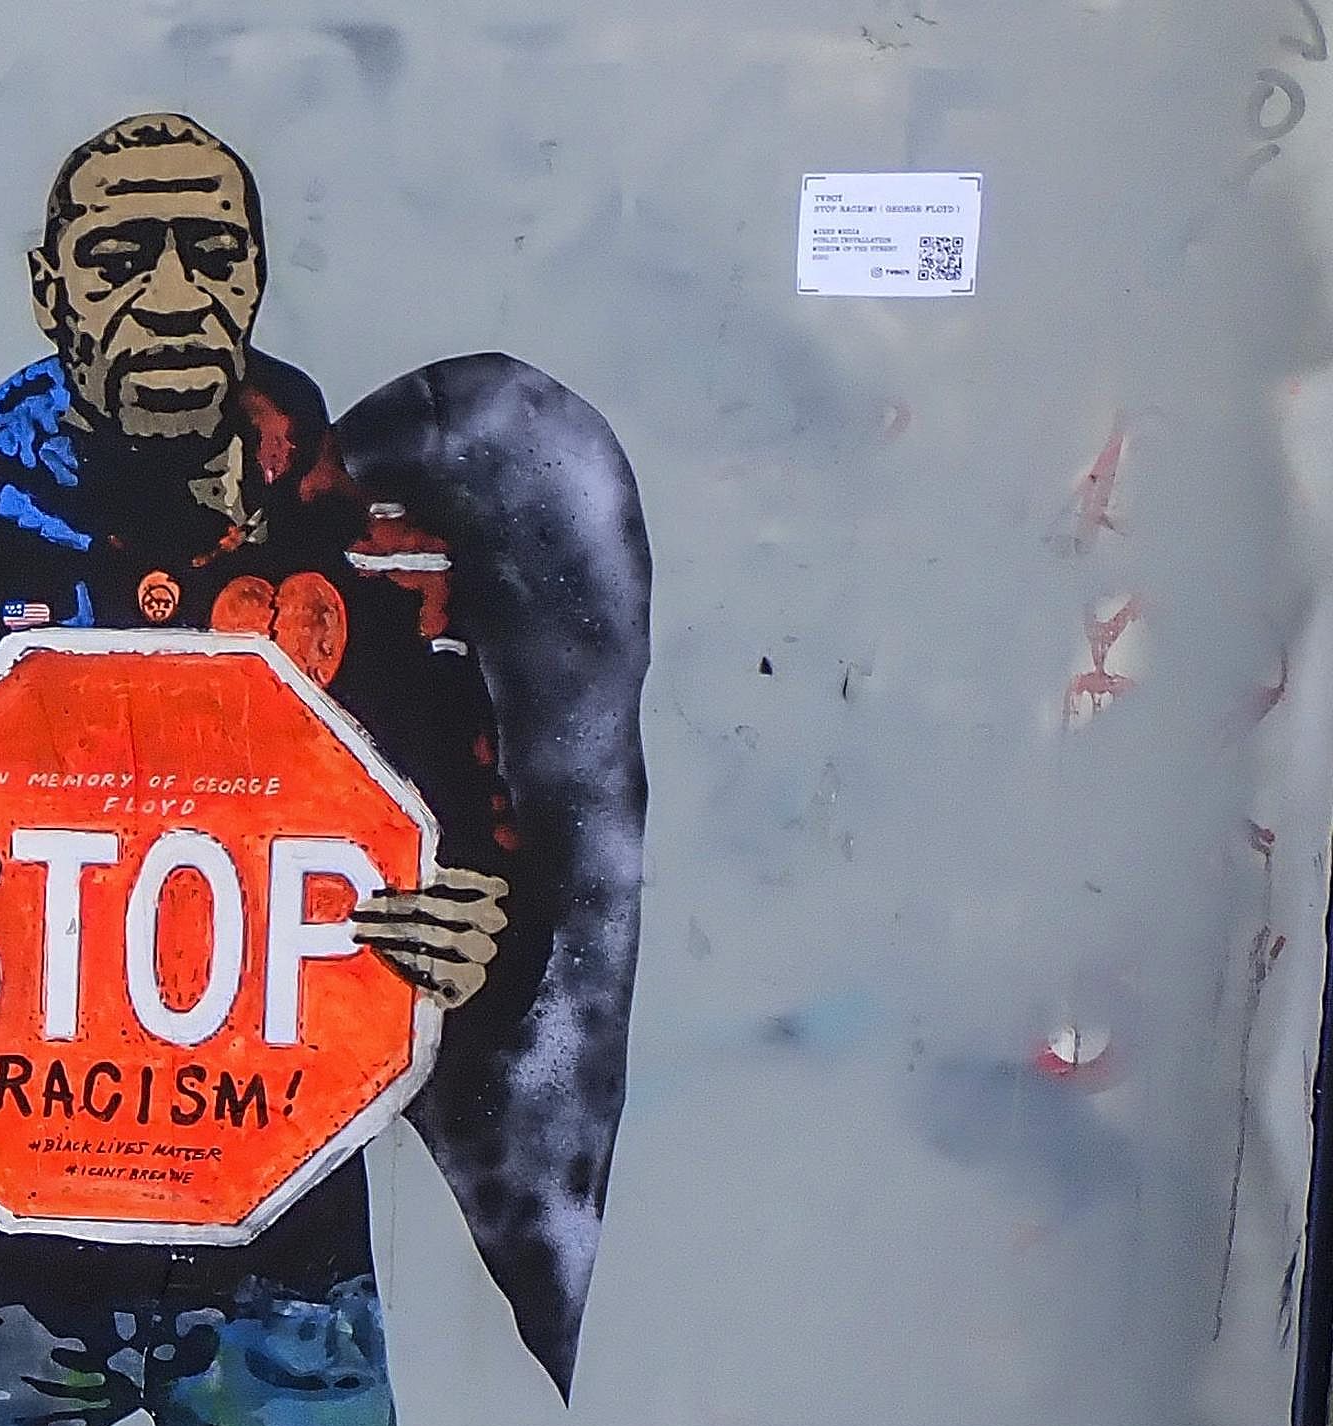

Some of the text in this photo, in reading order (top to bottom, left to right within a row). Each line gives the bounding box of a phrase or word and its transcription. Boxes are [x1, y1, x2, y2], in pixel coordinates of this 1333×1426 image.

[27, 772, 133, 788] MEMORY
[148, 774, 176, 790] OF
[192, 776, 281, 796] GEORGE
[103, 797, 196, 816] FLOYD
